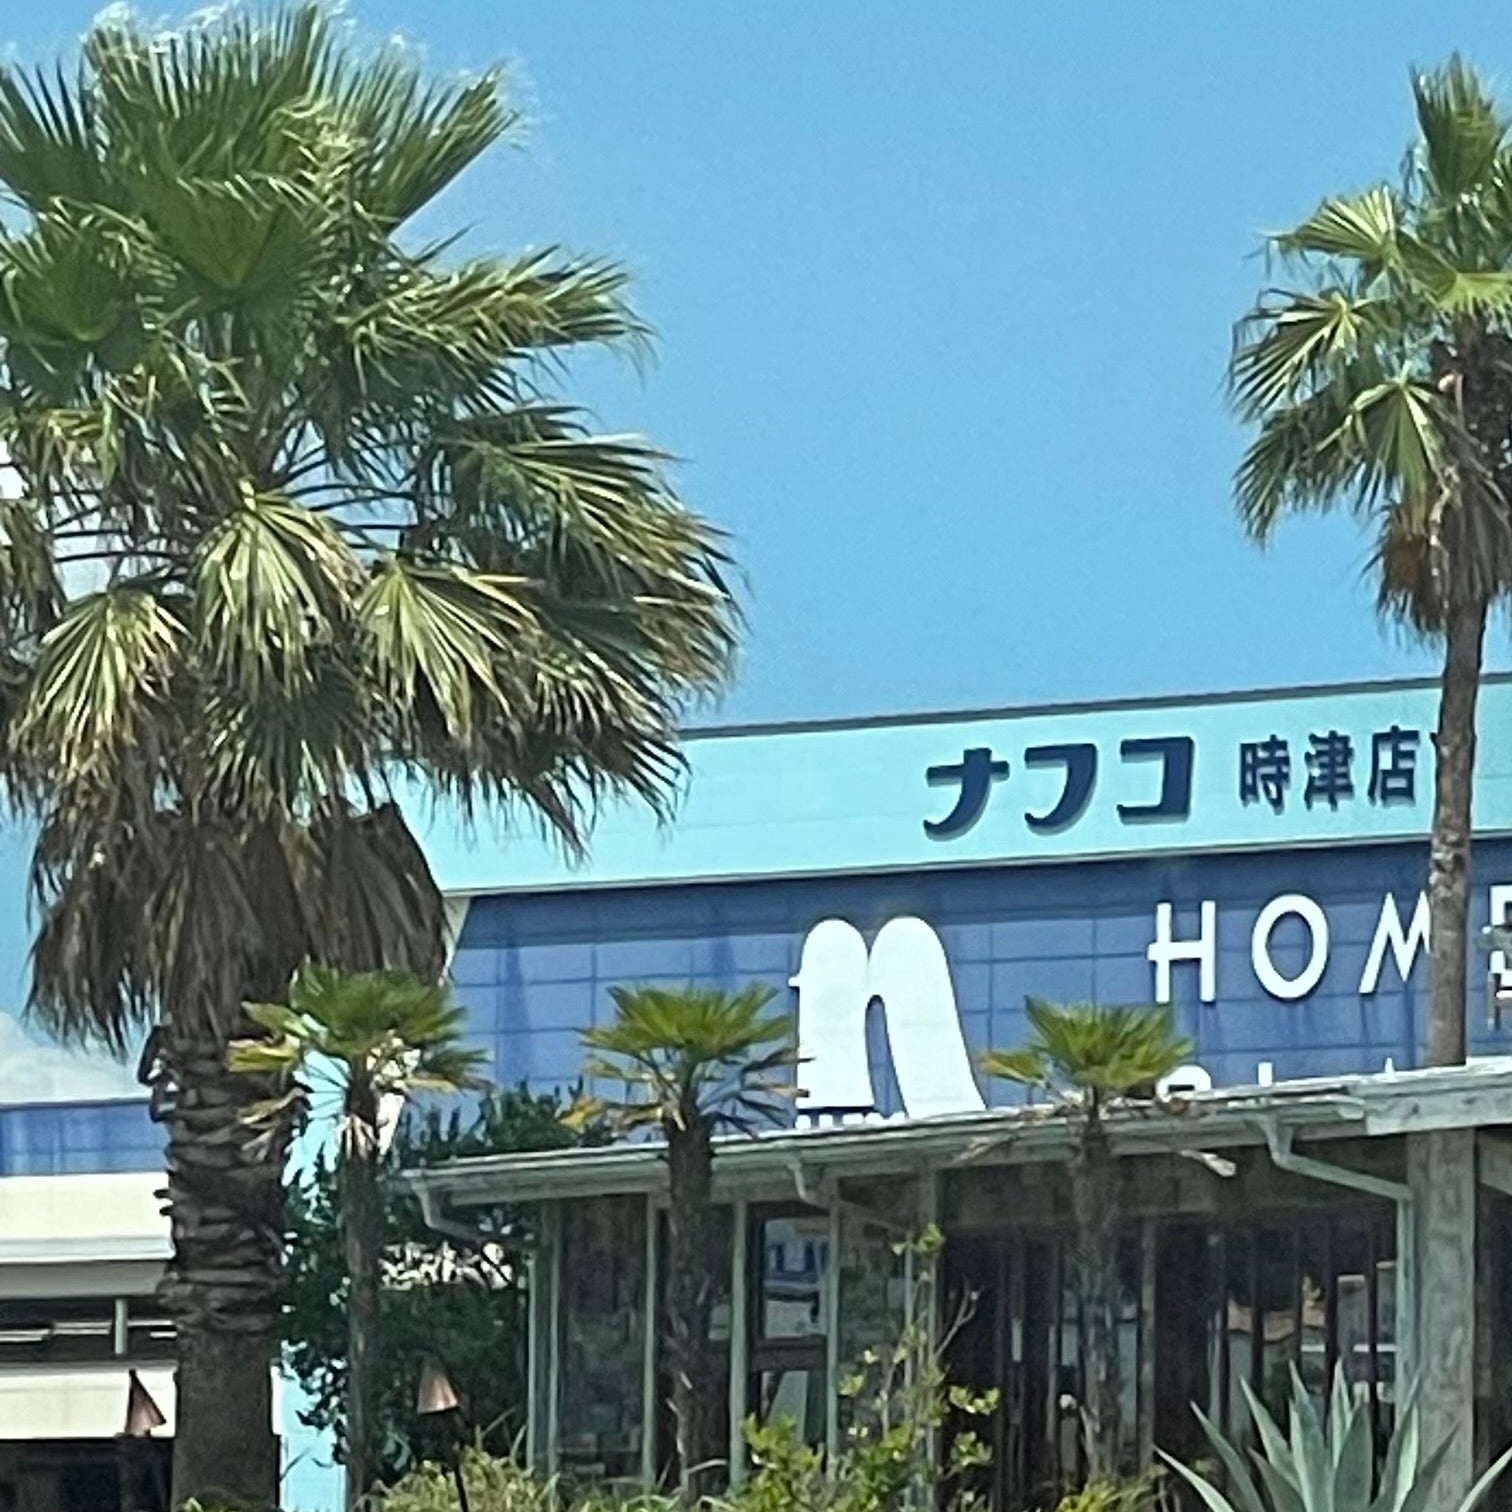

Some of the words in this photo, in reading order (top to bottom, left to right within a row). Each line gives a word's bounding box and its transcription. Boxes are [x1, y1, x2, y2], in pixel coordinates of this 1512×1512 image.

[924, 736, 1195, 838] ナフコ
[1240, 725, 1420, 814] 時津店
